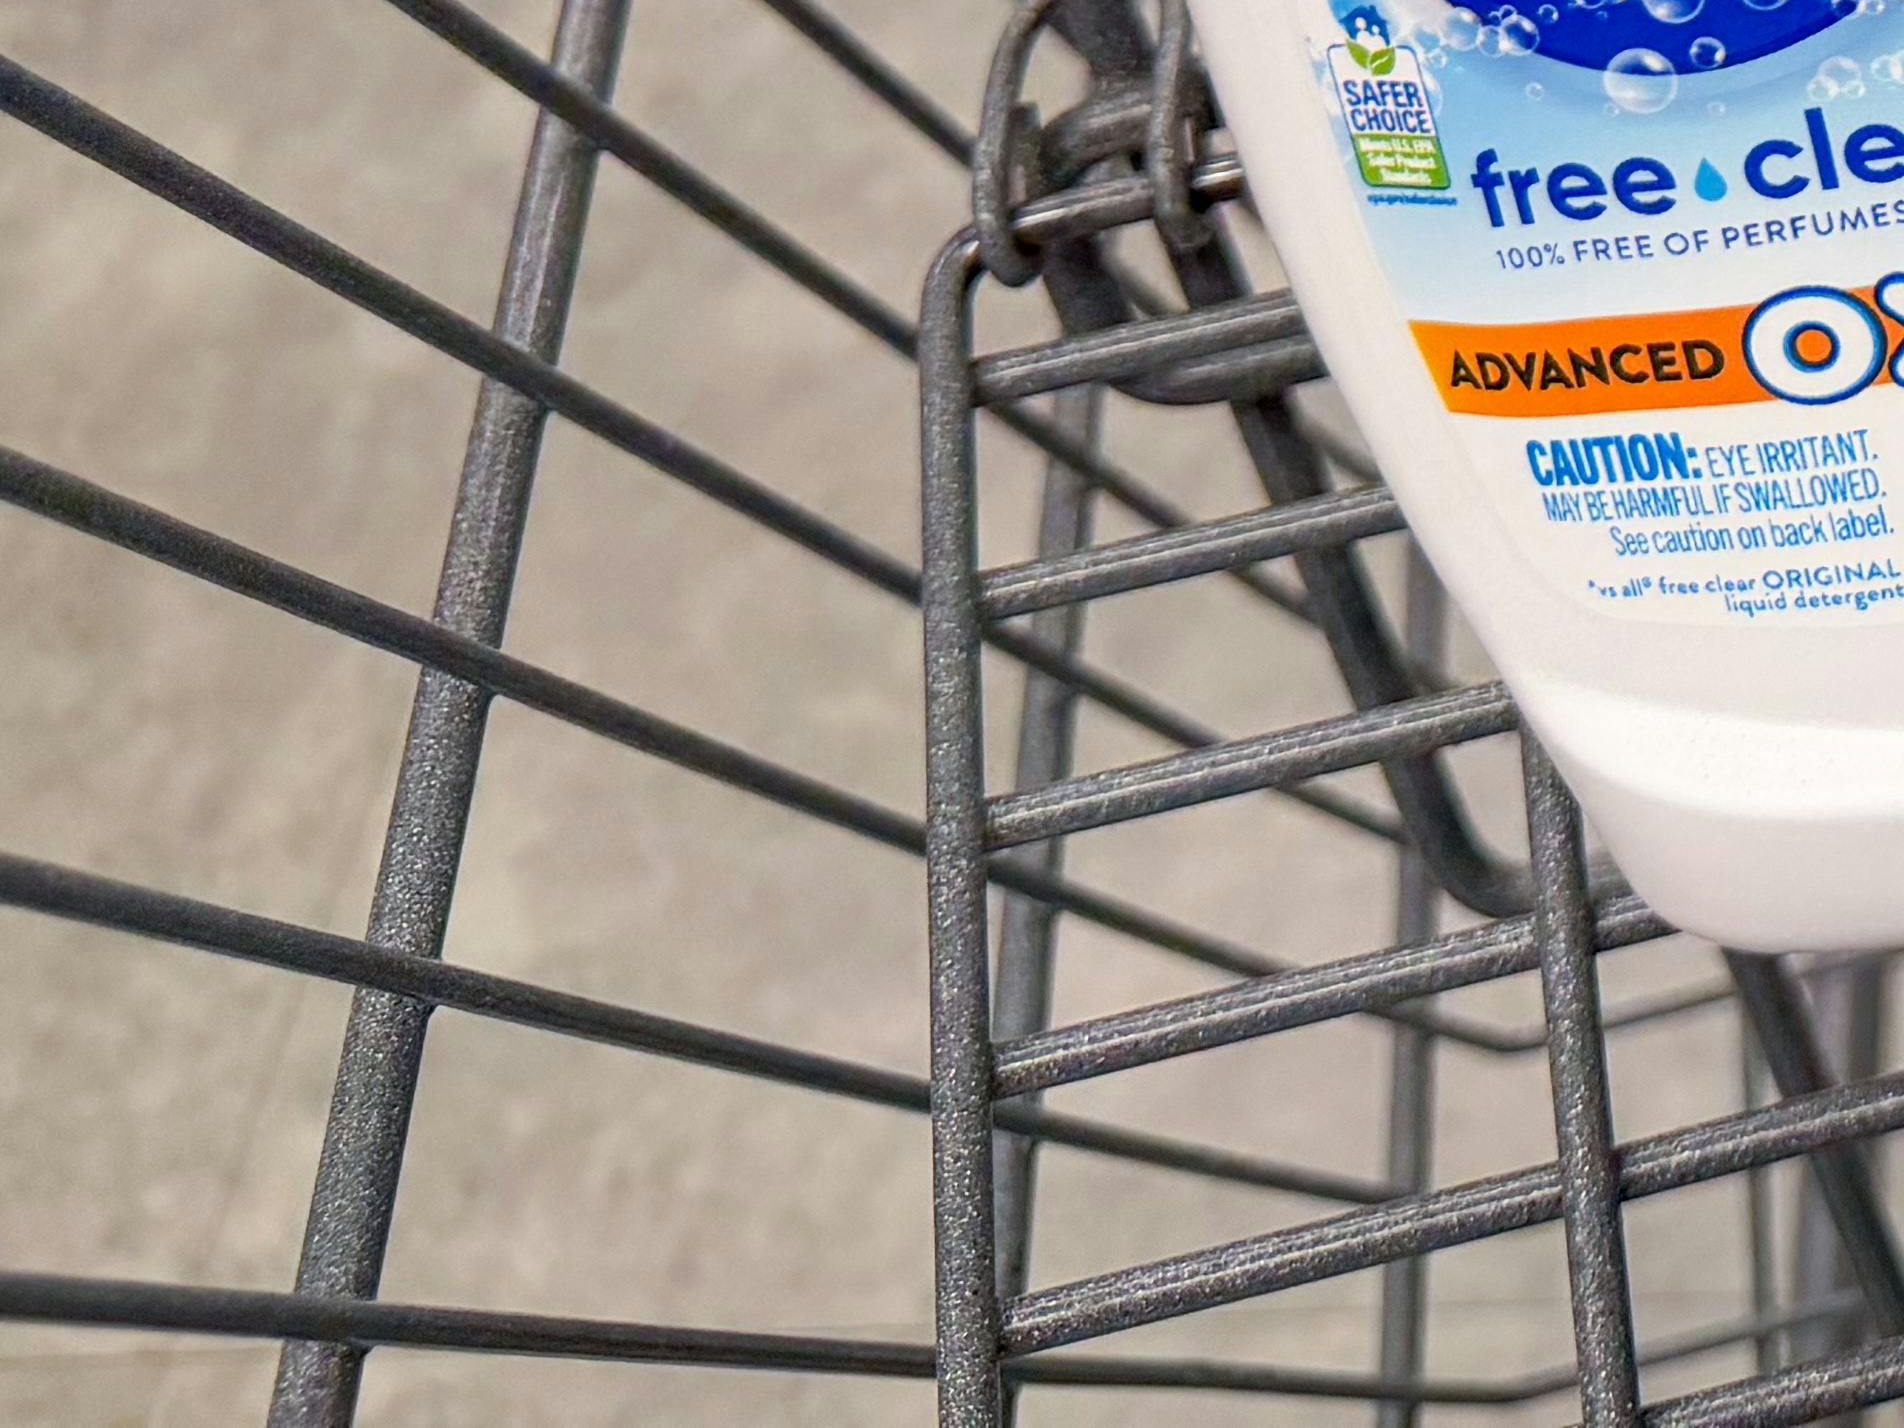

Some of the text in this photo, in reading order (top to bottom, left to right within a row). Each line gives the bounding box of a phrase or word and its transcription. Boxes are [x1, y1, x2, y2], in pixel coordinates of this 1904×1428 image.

[1342, 79, 1424, 109] SAFER
[1350, 108, 1432, 134] CHOICE
[1470, 147, 1678, 229] free
[1496, 241, 1566, 270] 100%
[1573, 230, 1656, 263] FREE
[1663, 228, 1710, 257] OF
[1449, 338, 1725, 392] ADVANCED
[1525, 428, 1879, 487] CAUTION: EYE IRRITANT.
[1541, 466, 1888, 523] MAY BE HARMFUL IF SWALLOWED.
[1609, 504, 1895, 558] See caution on back label.
[1658, 575, 1700, 595] free
[1704, 573, 1757, 593] clear
[1762, 558, 1903, 591] ORIGINAL
[1724, 592, 1788, 618] liquid
